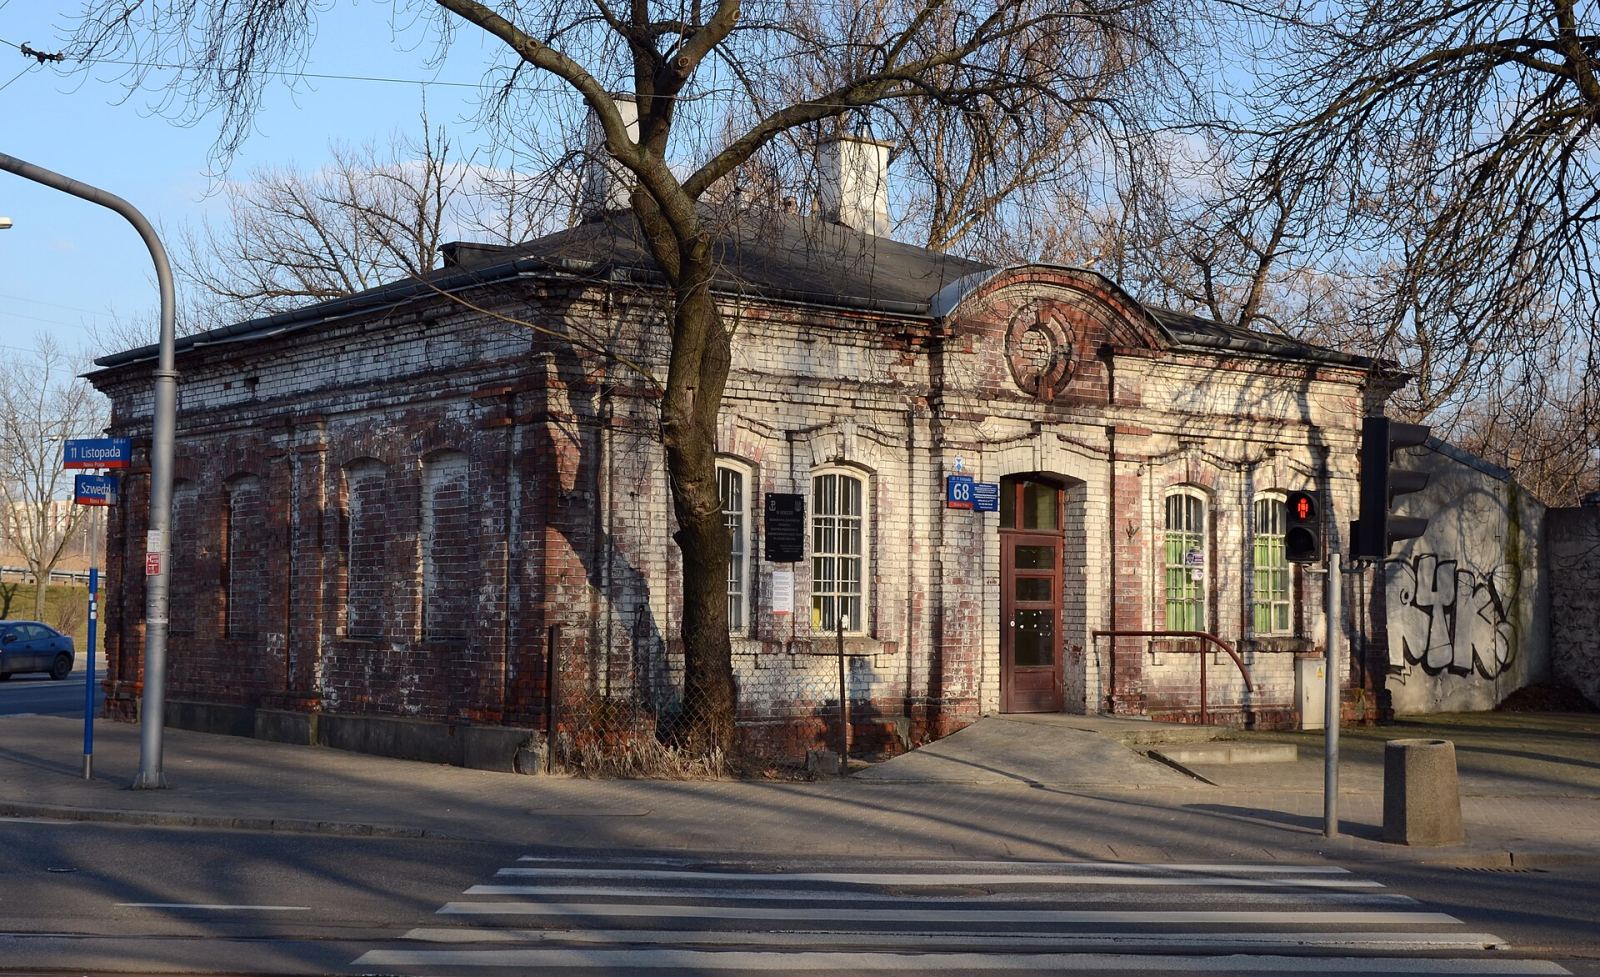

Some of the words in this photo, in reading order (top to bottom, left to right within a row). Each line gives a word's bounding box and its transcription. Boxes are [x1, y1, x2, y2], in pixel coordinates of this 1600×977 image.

[71, 447, 77, 459] 11
[81, 445, 121, 461] Listopada
[953, 483, 970, 501] 68
